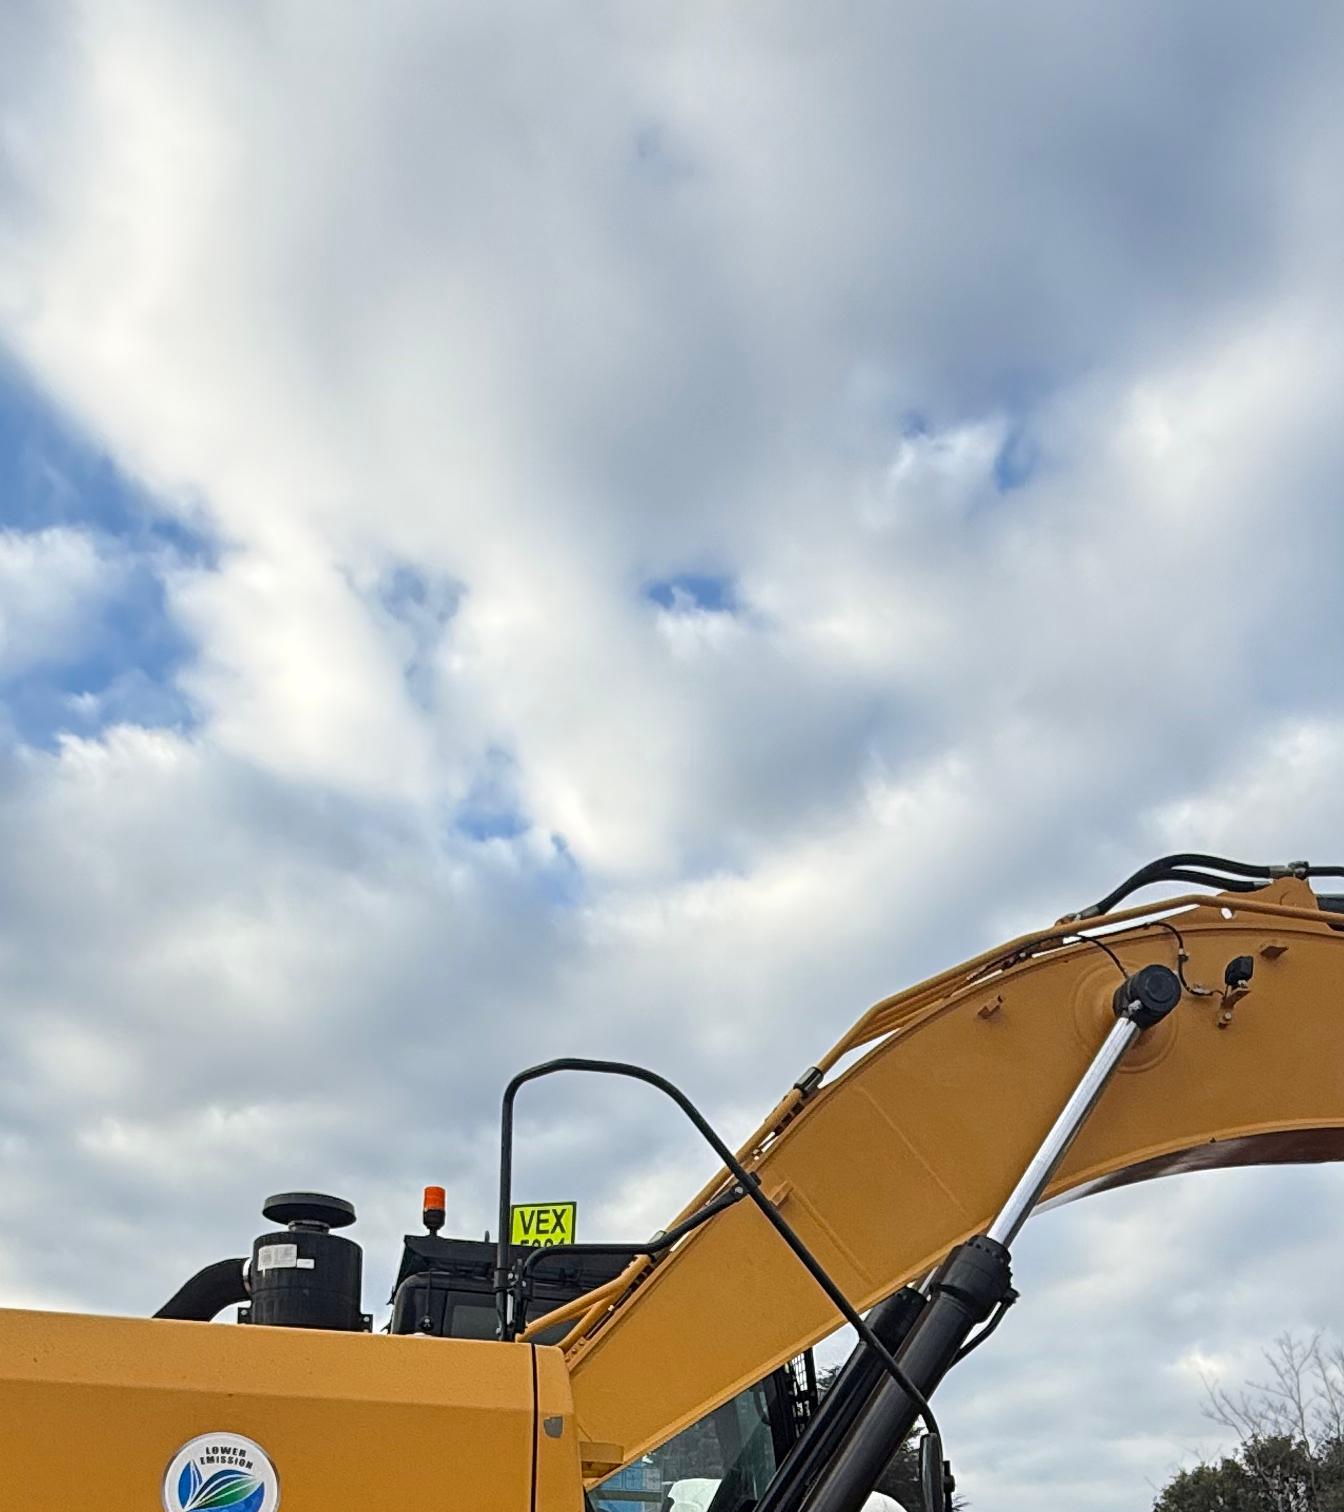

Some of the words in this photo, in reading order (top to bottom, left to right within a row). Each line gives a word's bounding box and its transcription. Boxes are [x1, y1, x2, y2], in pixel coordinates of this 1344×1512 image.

[519, 1209, 567, 1235] VEX
[206, 1446, 247, 1457] LOWER
[200, 1456, 254, 1470] EMISSION
